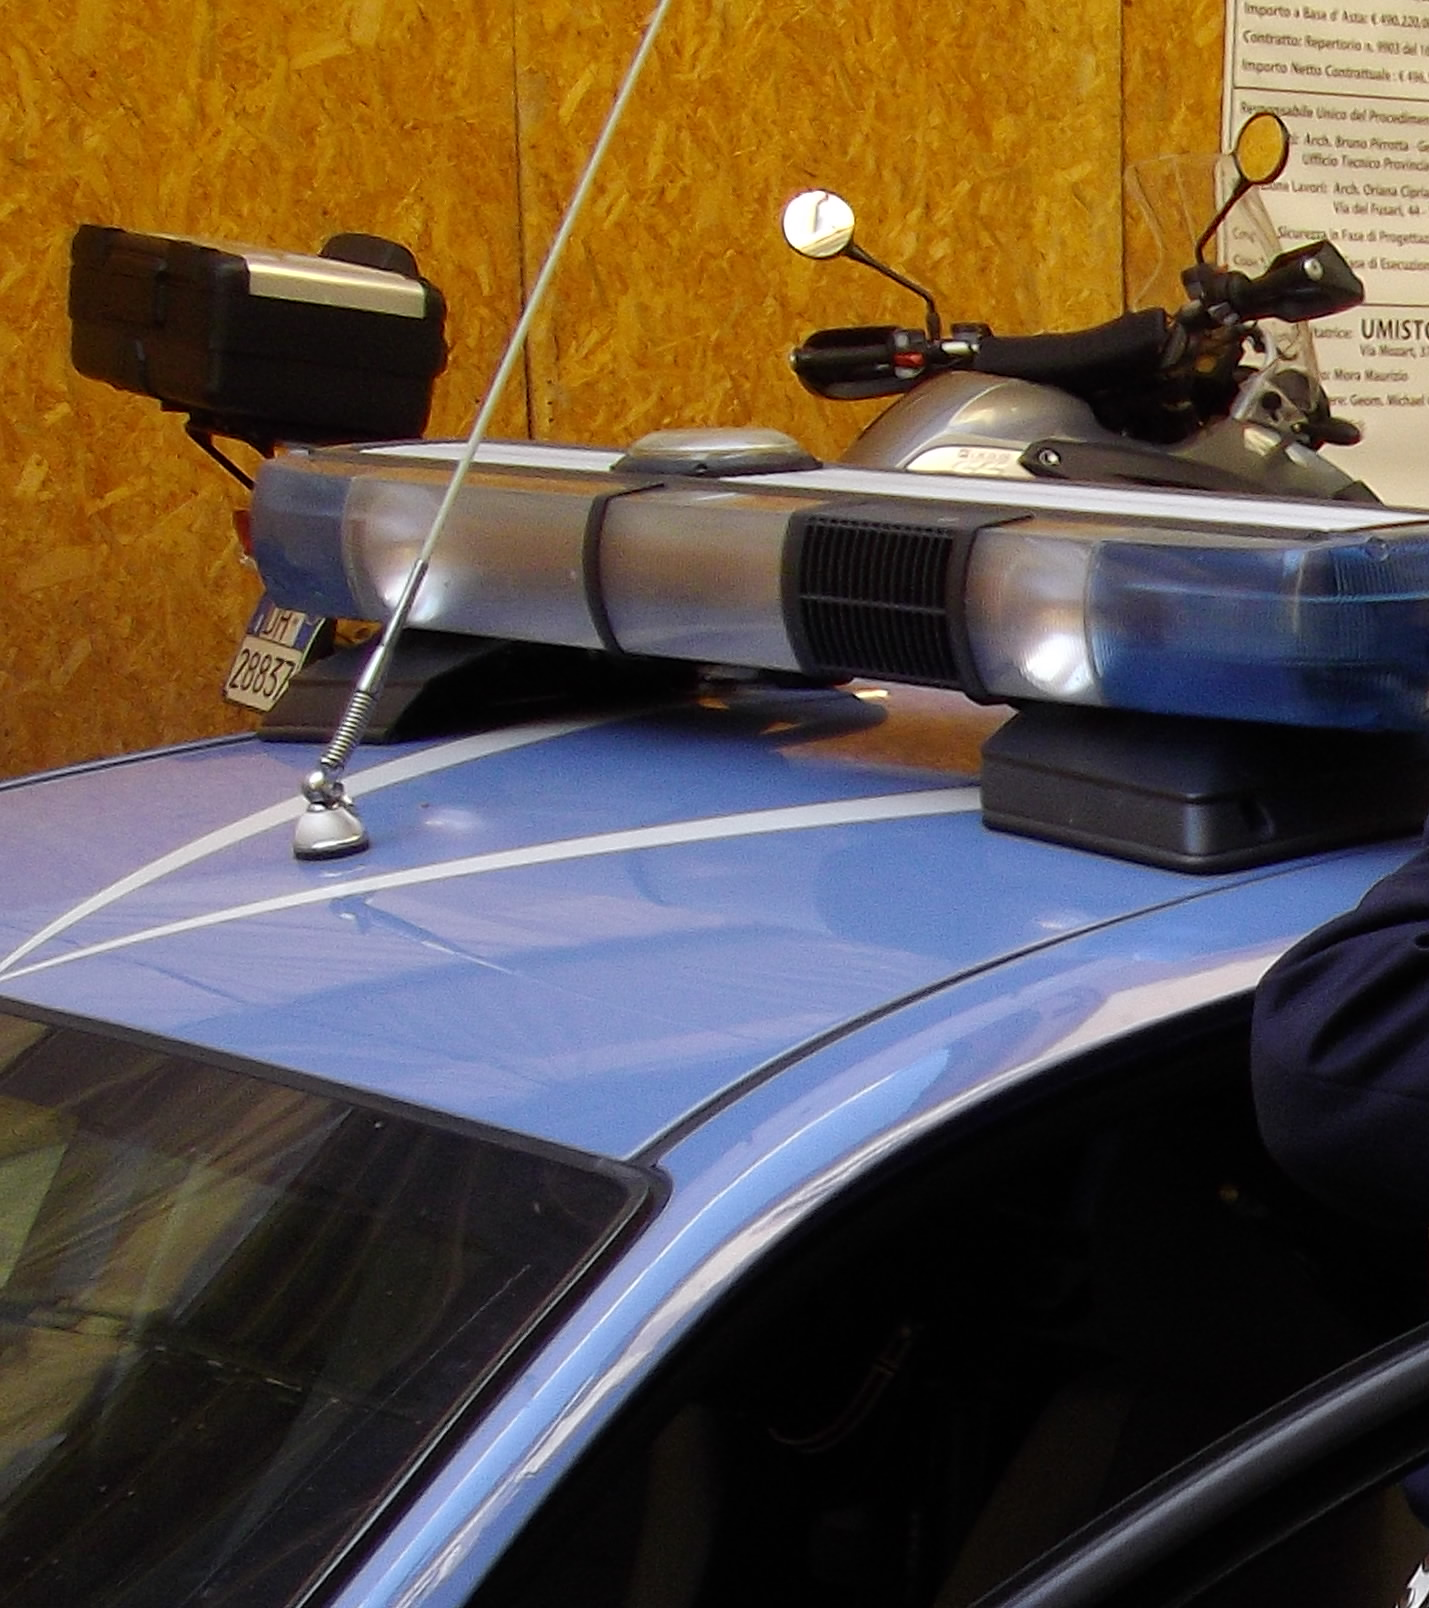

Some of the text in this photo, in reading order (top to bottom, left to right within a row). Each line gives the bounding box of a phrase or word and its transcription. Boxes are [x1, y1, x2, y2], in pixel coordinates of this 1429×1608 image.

[1244, 2, 1291, 19] Importo
[1303, 7, 1327, 20] Base
[1243, 30, 1301, 46] Contratto:
[1305, 35, 1361, 51] Repertorio
[1403, 42, 1417, 55] del
[1243, 59, 1287, 76] Importo
[1291, 61, 1321, 75] Netto
[1316, 107, 1346, 120] Unico
[1350, 108, 1366, 121] del
[1304, 133, 1332, 147] Arch.
[1335, 135, 1366, 149] Bruno
[1302, 153, 1338, 167] Ufficio
[1342, 154, 1379, 169] Tecnico
[1384, 158, 1429, 171] Provincia
[1292, 180, 1326, 193] Lavori:
[1333, 183, 1359, 196] Arch.
[1363, 184, 1397, 196] Oriana
[1333, 201, 1349, 214] Via
[1278, 226, 1326, 240] Sicurezza
[1342, 229, 1364, 241] Fase
[1368, 230, 1377, 242] di
[1368, 258, 1377, 269] di
[1360, 345, 1375, 356] Via
[1365, 369, 1409, 381] Maurizio
[1350, 393, 1383, 406] Geom.
[1387, 393, 1424, 406] Michael
